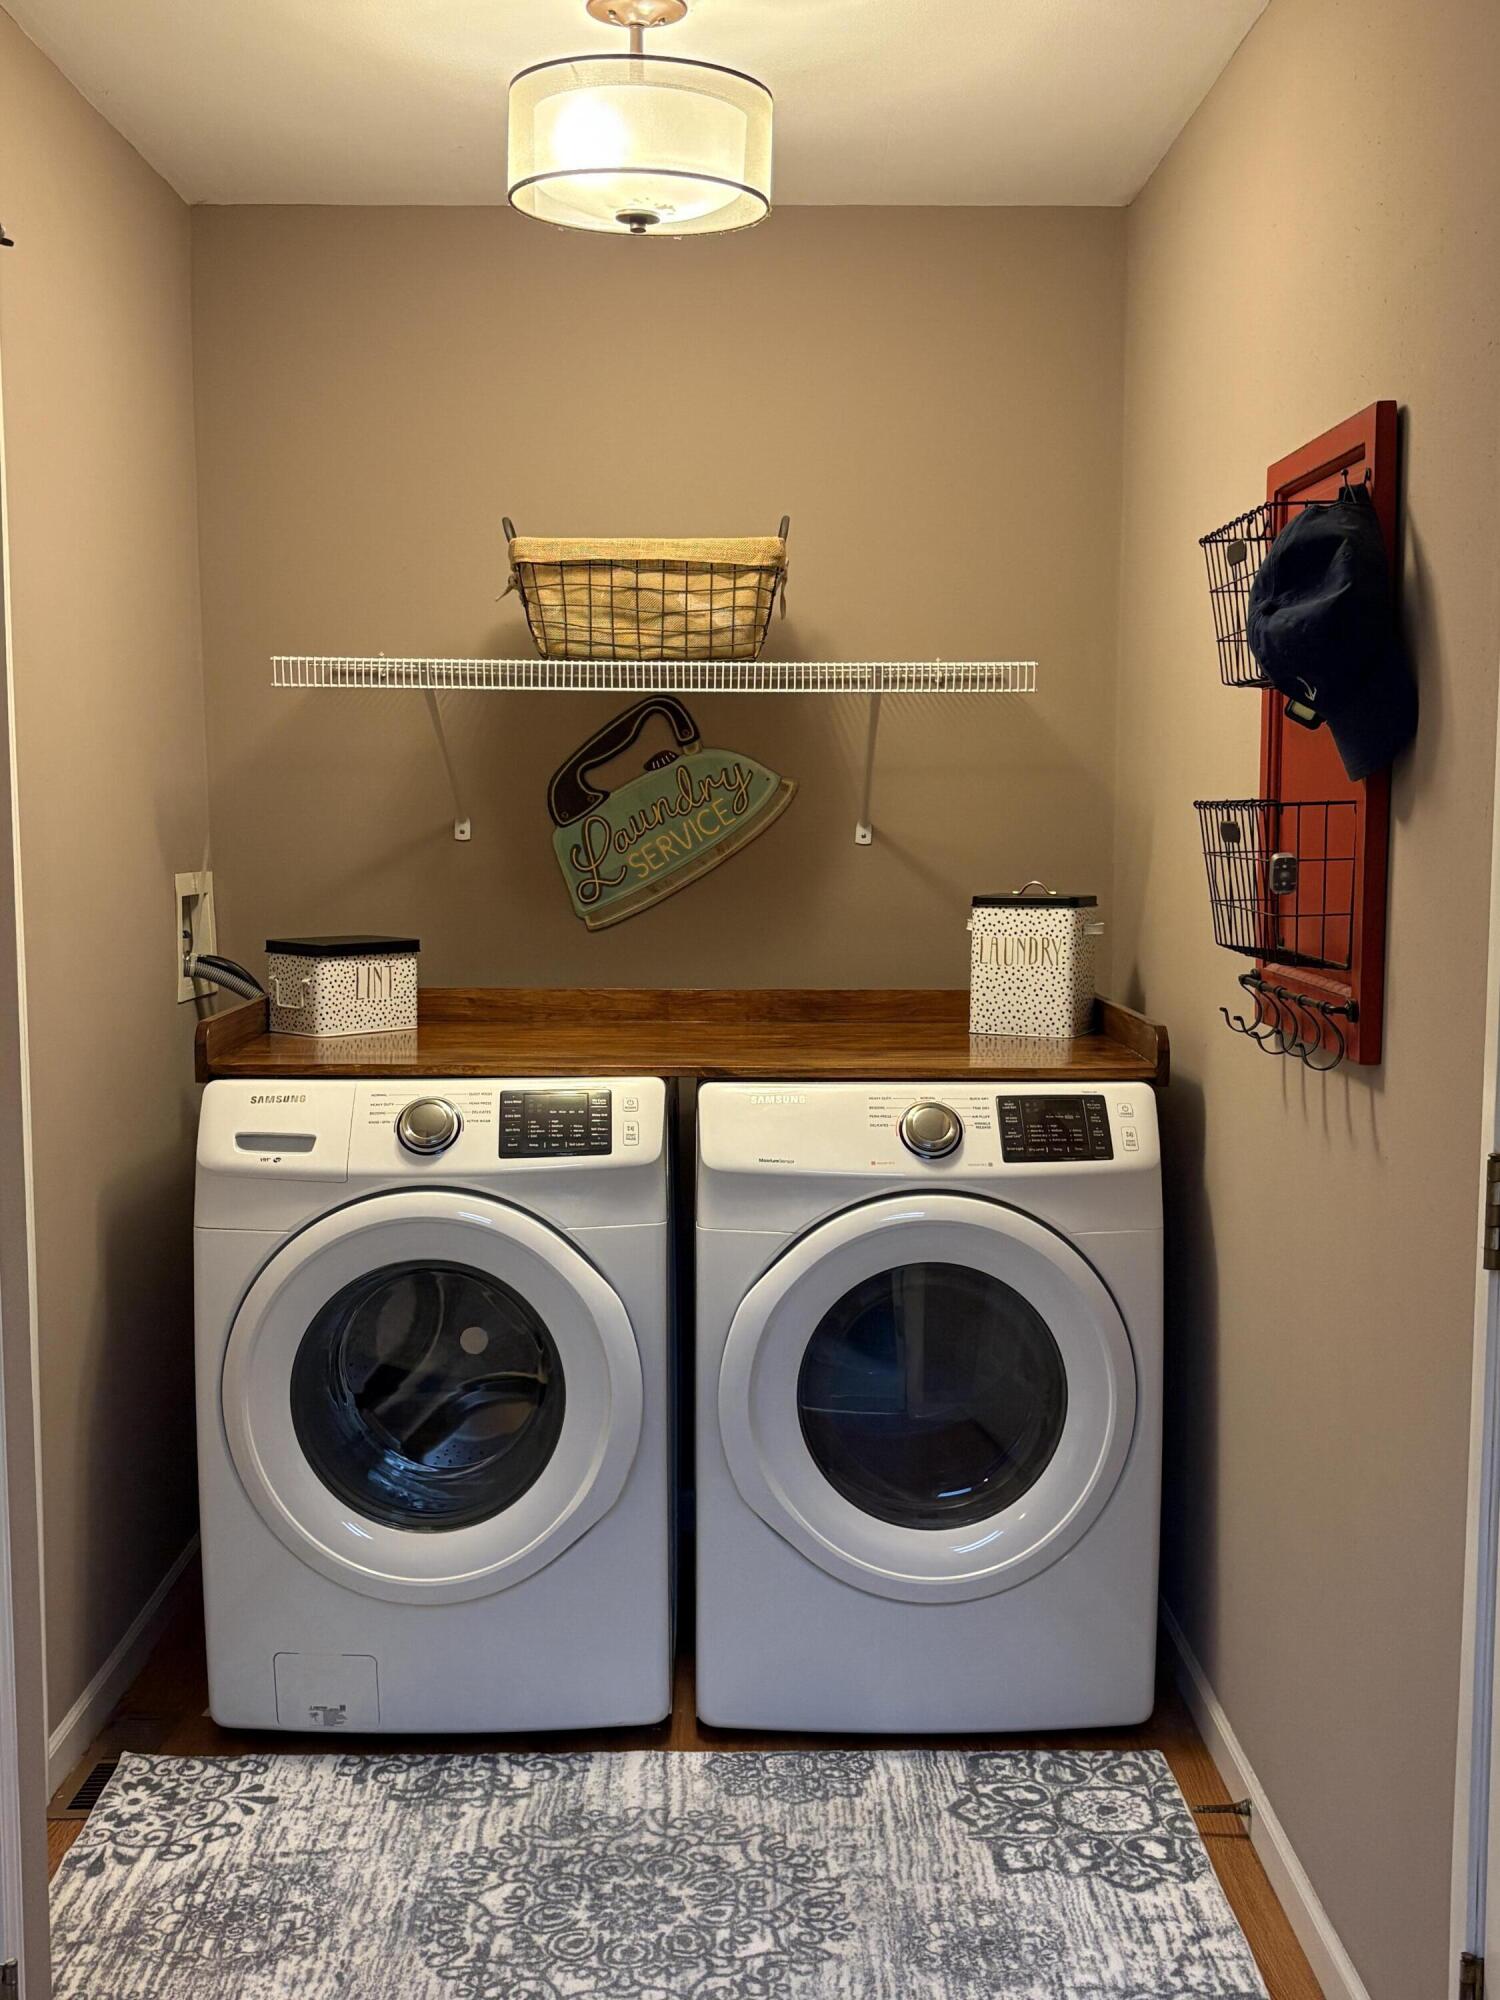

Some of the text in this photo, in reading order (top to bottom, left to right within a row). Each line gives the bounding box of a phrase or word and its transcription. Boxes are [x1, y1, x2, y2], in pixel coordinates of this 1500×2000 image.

[570, 762, 753, 906] Laundry
[626, 797, 737, 878] SERVICE
[979, 936, 1062, 967] LAUNDRY
[355, 965, 395, 1001] LINT
[250, 1094, 307, 1104] SAMSUNG
[750, 1095, 807, 1105] SAMSUNG
